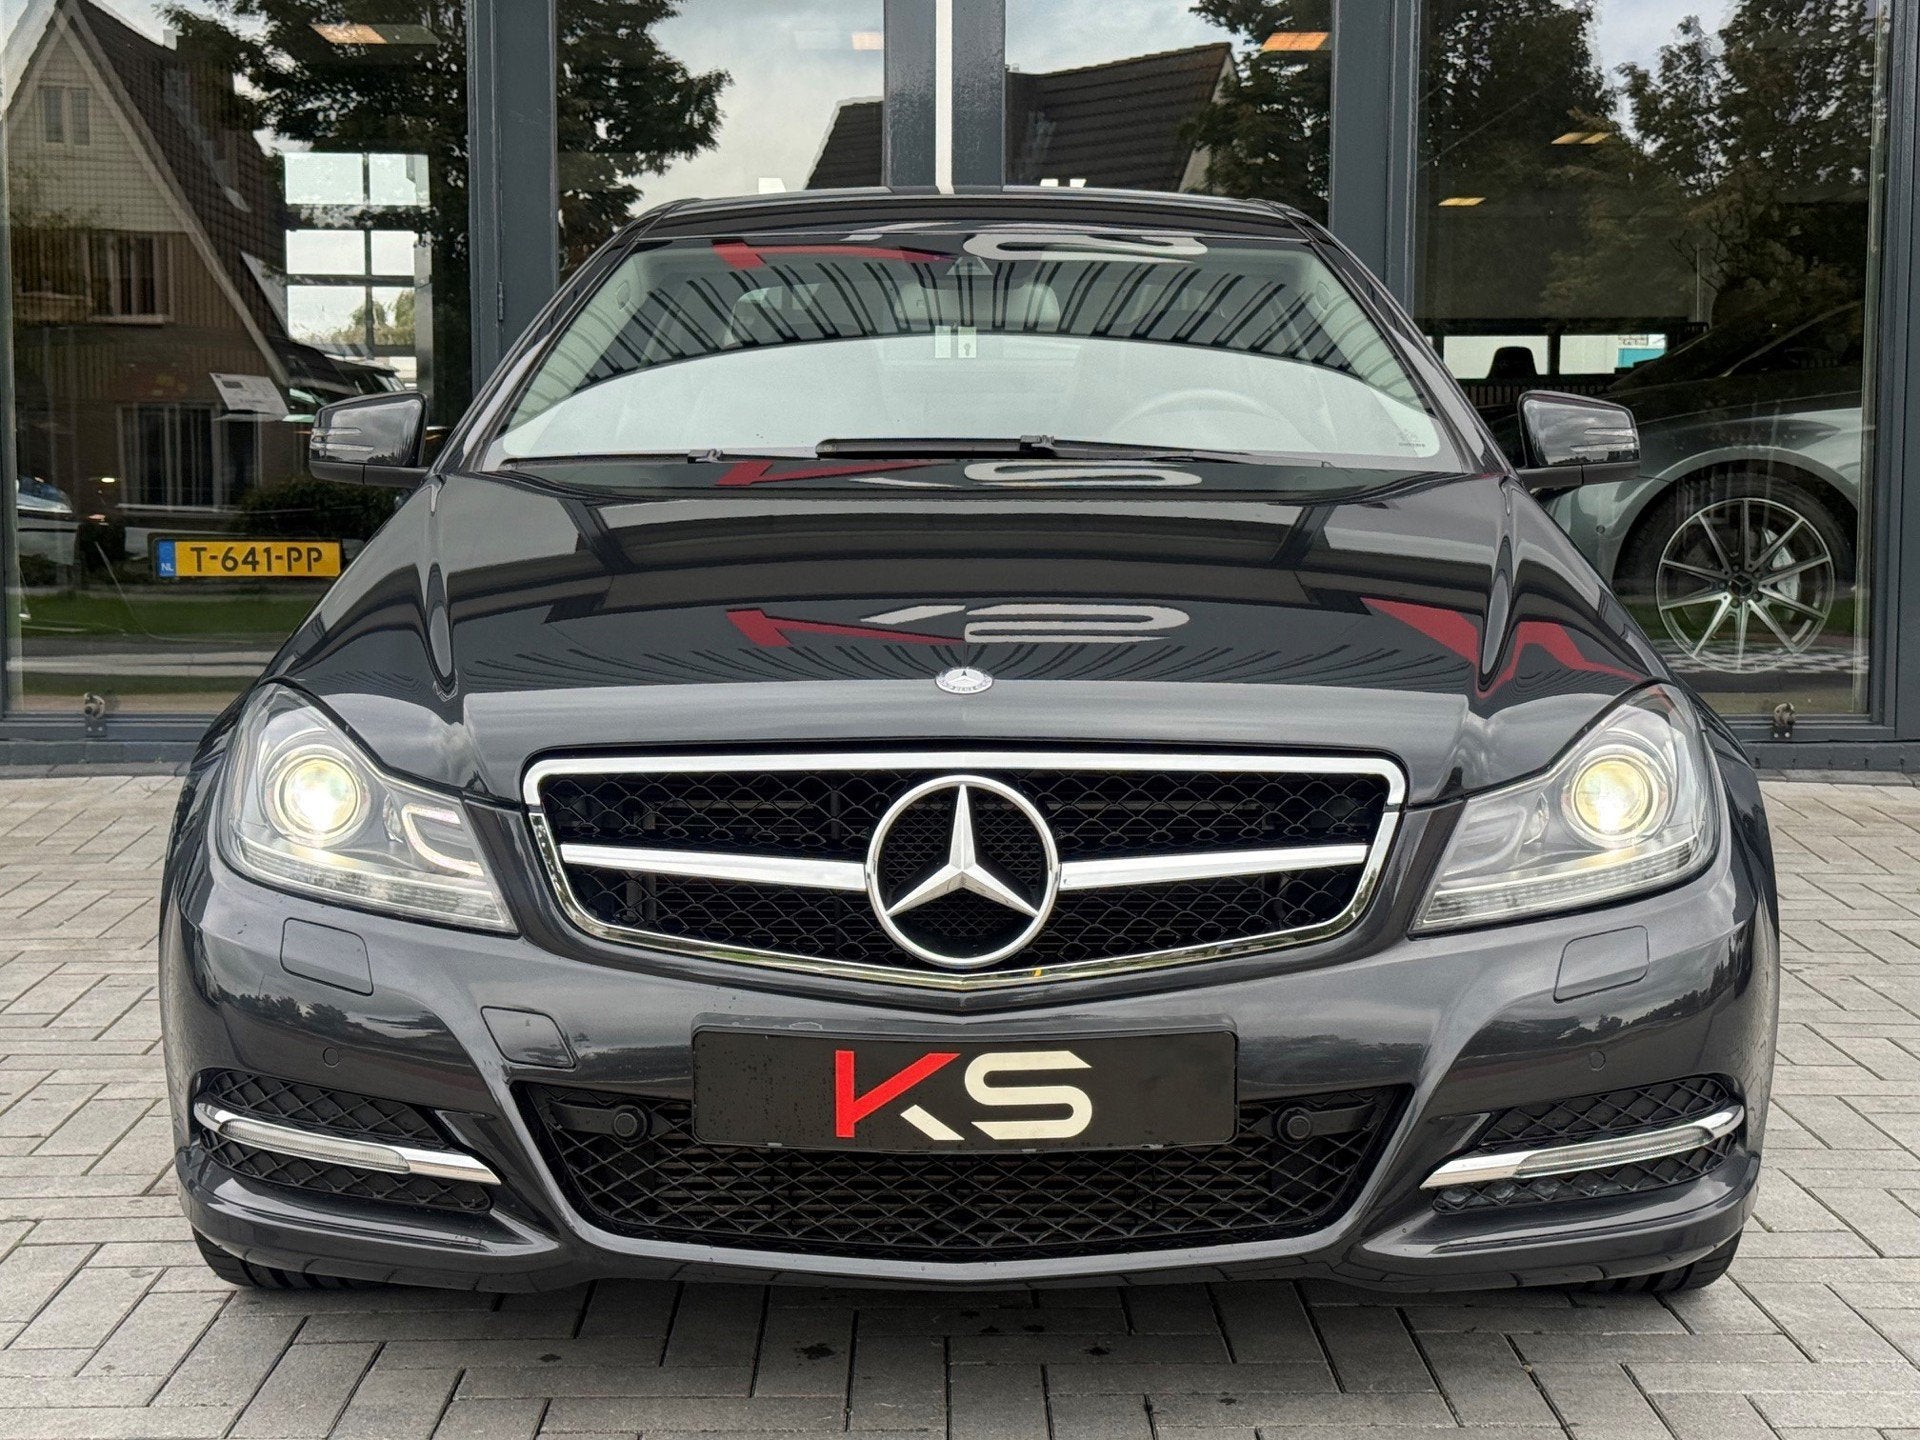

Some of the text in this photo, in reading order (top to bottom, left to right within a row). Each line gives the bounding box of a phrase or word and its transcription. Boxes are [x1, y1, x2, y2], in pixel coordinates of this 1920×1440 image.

[160, 562, 174, 571] NL
[190, 546, 323, 572] T-641-PP
[835, 1050, 1093, 1141] KS
